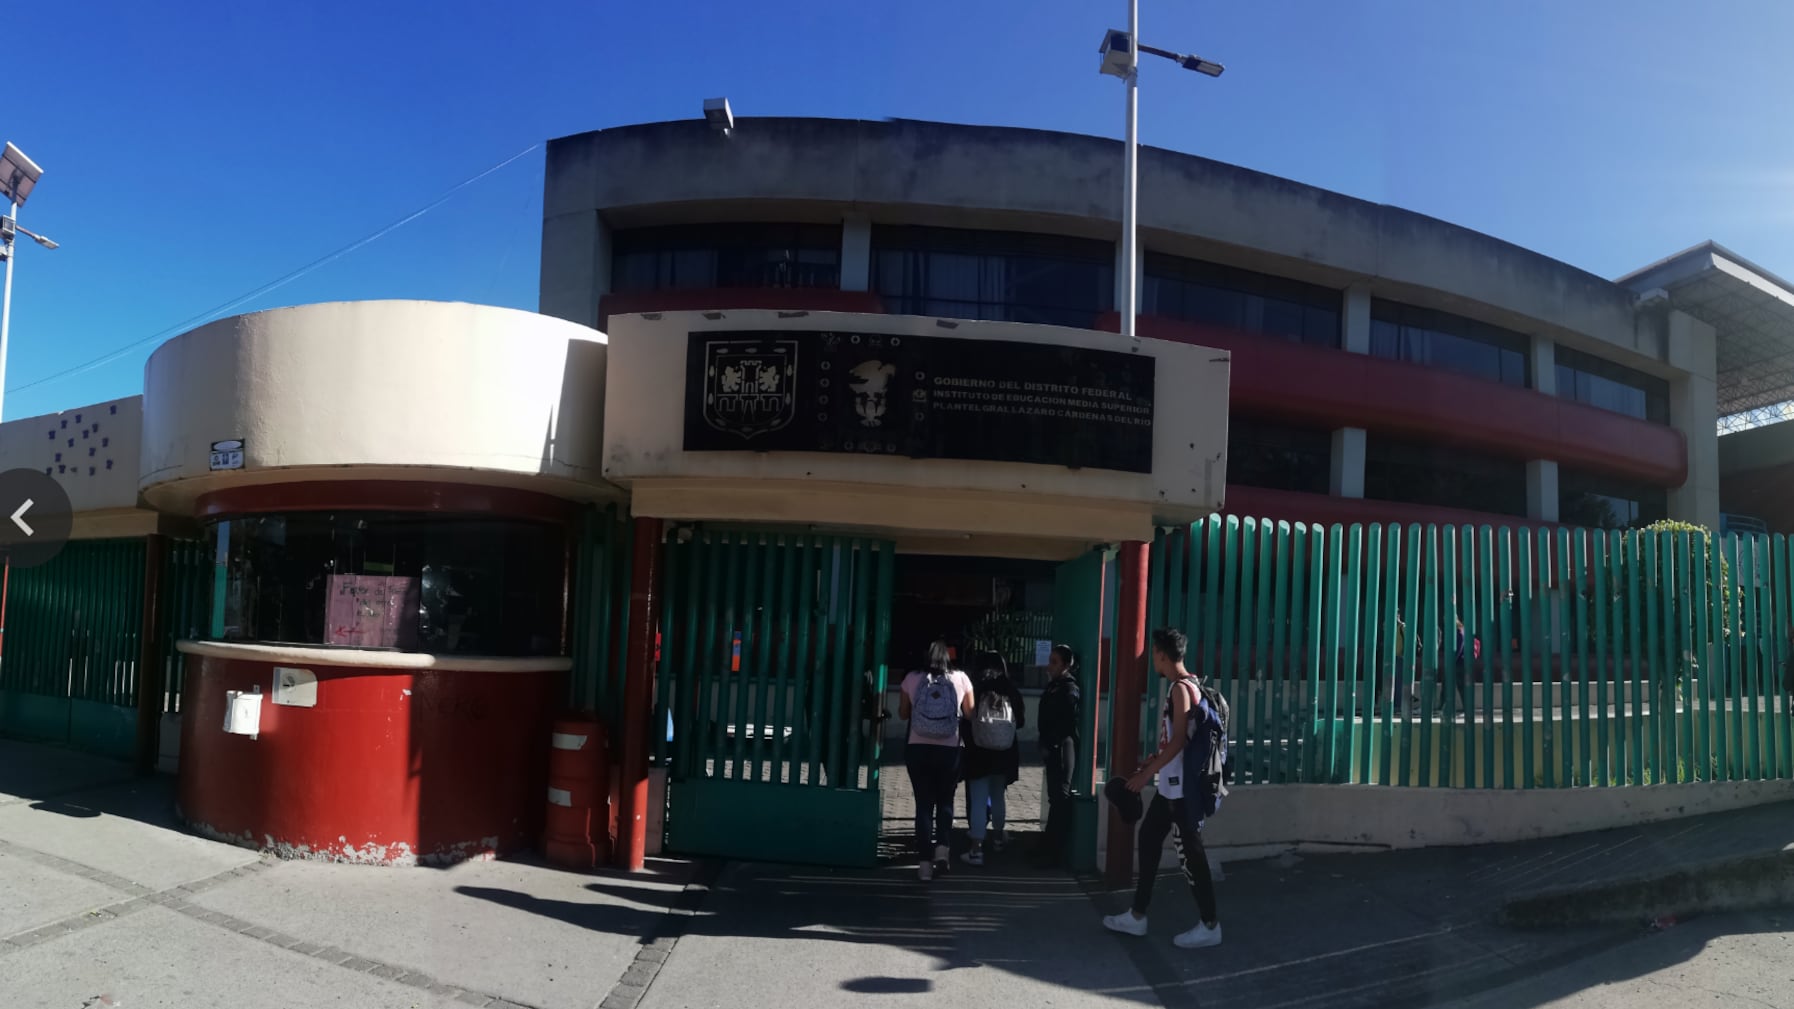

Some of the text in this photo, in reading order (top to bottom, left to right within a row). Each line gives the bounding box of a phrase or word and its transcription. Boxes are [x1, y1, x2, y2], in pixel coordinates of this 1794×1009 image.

[934, 377, 1132, 400] GOBIERNO DEL DISTRITO FEDERAL
[933, 389, 1149, 415] INSTITUTO DE EDUCACION MEDIA SUPERIOR
[933, 400, 980, 411] PLANTEL
[1011, 405, 1055, 416] LAZARO
[1114, 414, 1133, 424] DEL
